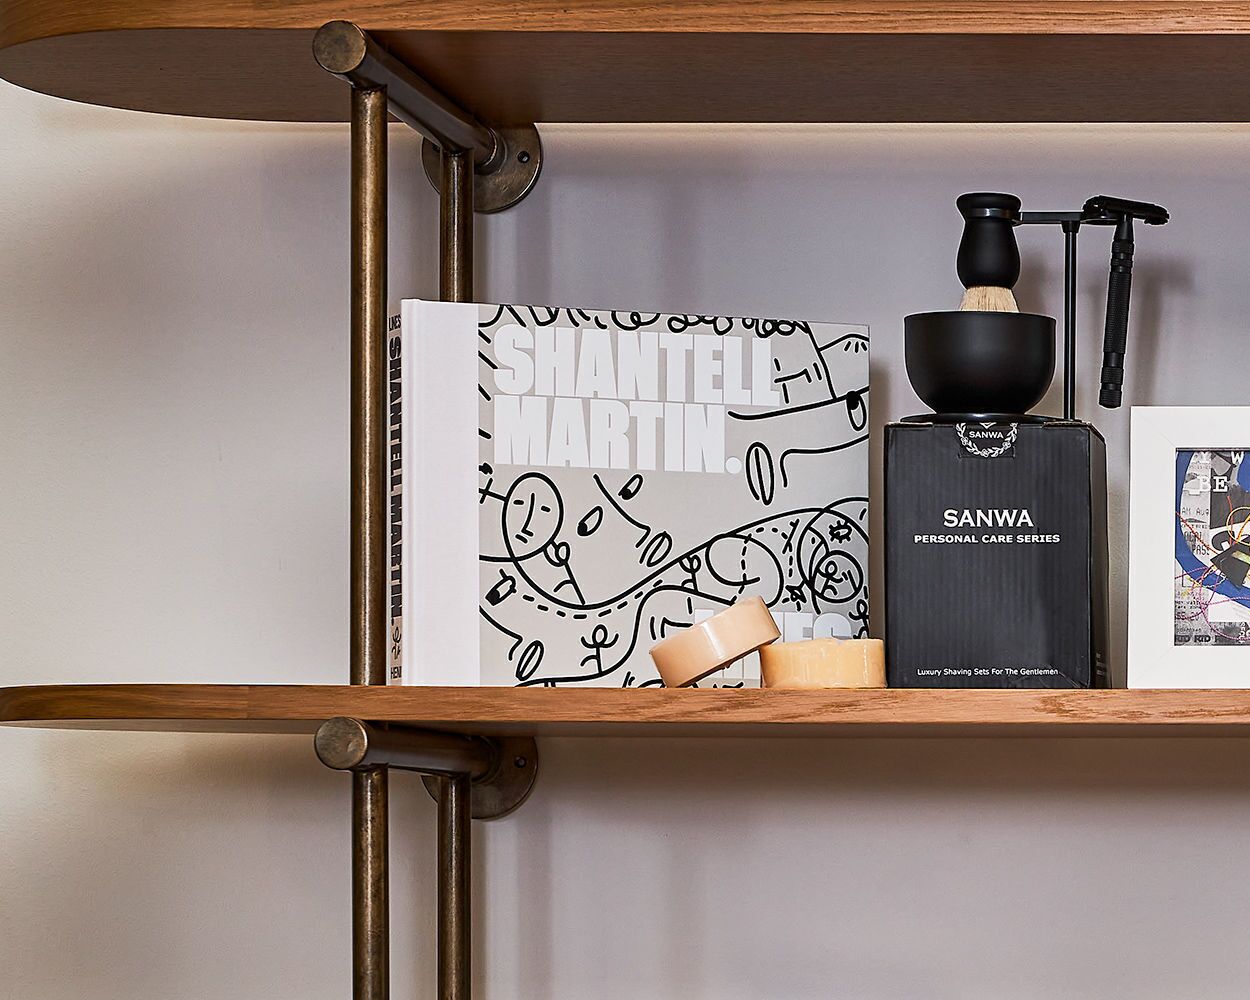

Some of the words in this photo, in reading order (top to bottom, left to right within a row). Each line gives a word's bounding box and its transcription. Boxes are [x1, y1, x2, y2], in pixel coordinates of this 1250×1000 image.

[493, 323, 780, 407] SHANTELL
[389, 336, 403, 494] SHANTELL
[493, 393, 742, 474] MARTIN.
[968, 430, 1005, 439] SANWA
[943, 508, 1034, 528] SANWA
[914, 534, 979, 544] PERSONAL
[981, 534, 1014, 544] CARE
[1016, 533, 1061, 544] SERIES
[917, 668, 942, 677] Luxury
[943, 667, 972, 677] Shaving
[973, 667, 990, 676] Sets
[991, 667, 1004, 676] For
[1005, 667, 1018, 676] The
[1019, 667, 1059, 676] Gentlemen
